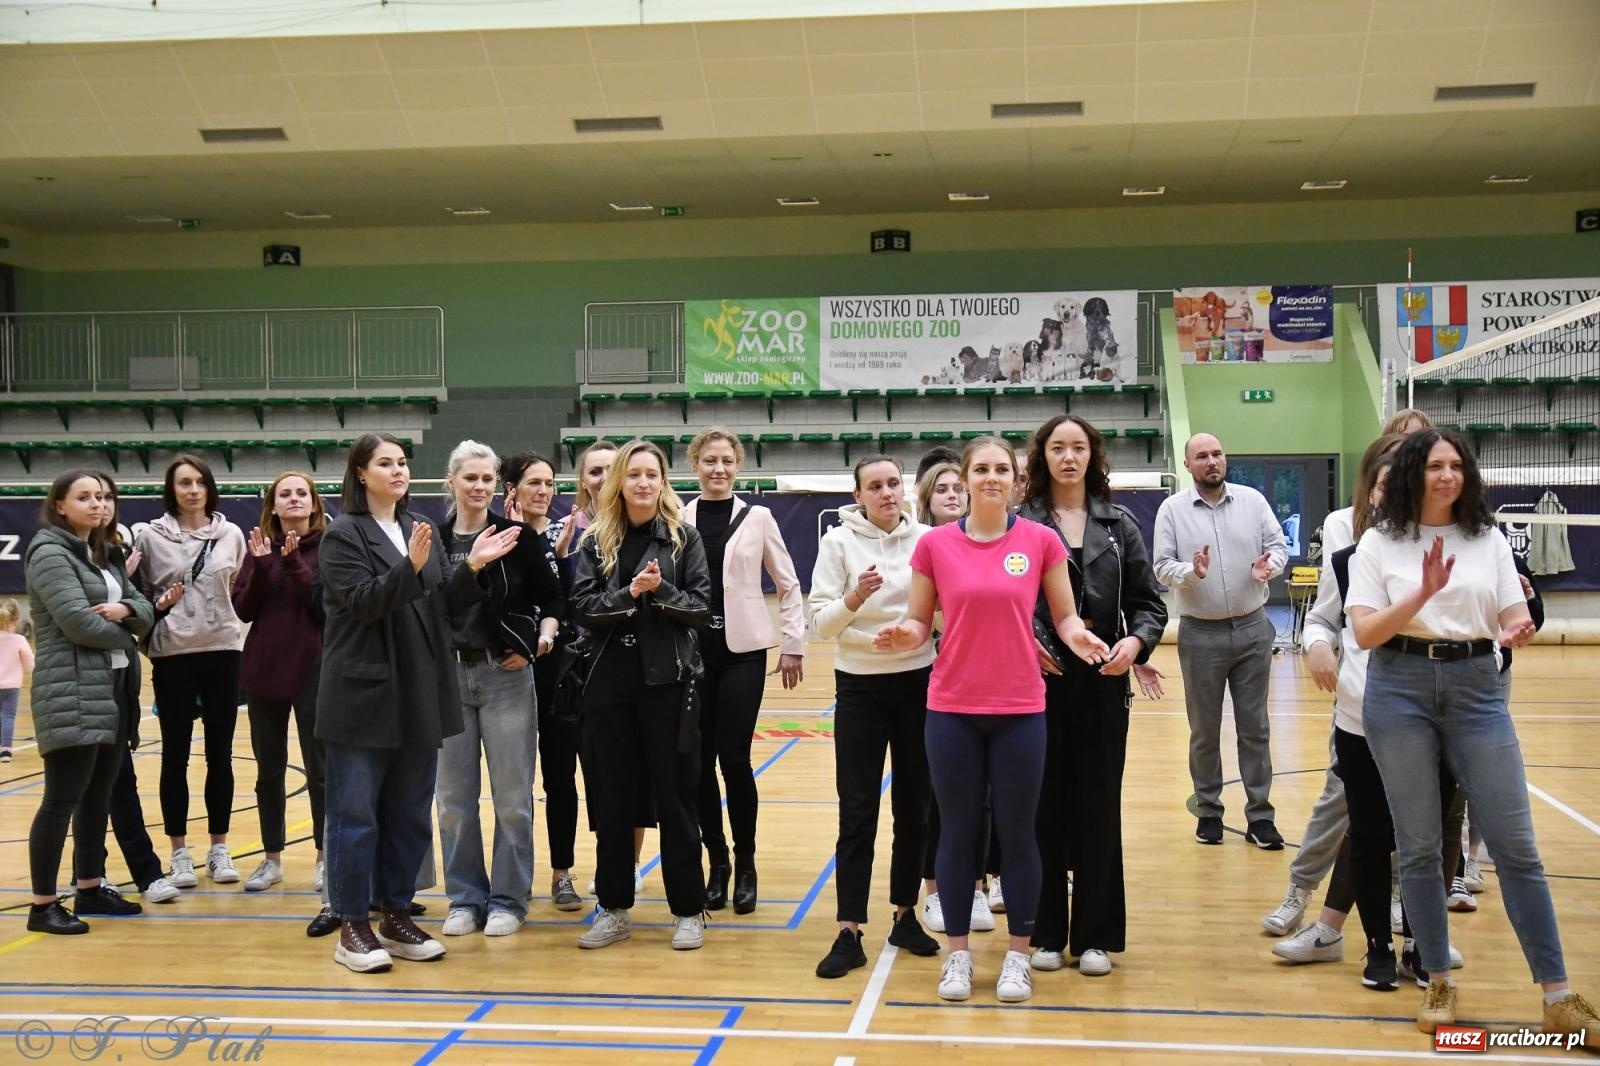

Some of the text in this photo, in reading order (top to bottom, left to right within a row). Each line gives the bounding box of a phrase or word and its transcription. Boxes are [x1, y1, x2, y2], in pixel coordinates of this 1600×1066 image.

[1581, 216, 1598, 229] C
[874, 238, 885, 250] B
[893, 237, 906, 249] B
[279, 252, 297, 264] A
[1277, 295, 1327, 305] Flexadin
[830, 297, 1020, 318] WSZYSTKO DLA TWOJEGO
[741, 309, 808, 333] ZOO
[830, 319, 961, 339] DOMOWEGO ZOO
[736, 332, 806, 354] MAR
[760, 354, 806, 363] zoologiczny
[704, 371, 807, 385] WWW.ZOO-MAR.PL
